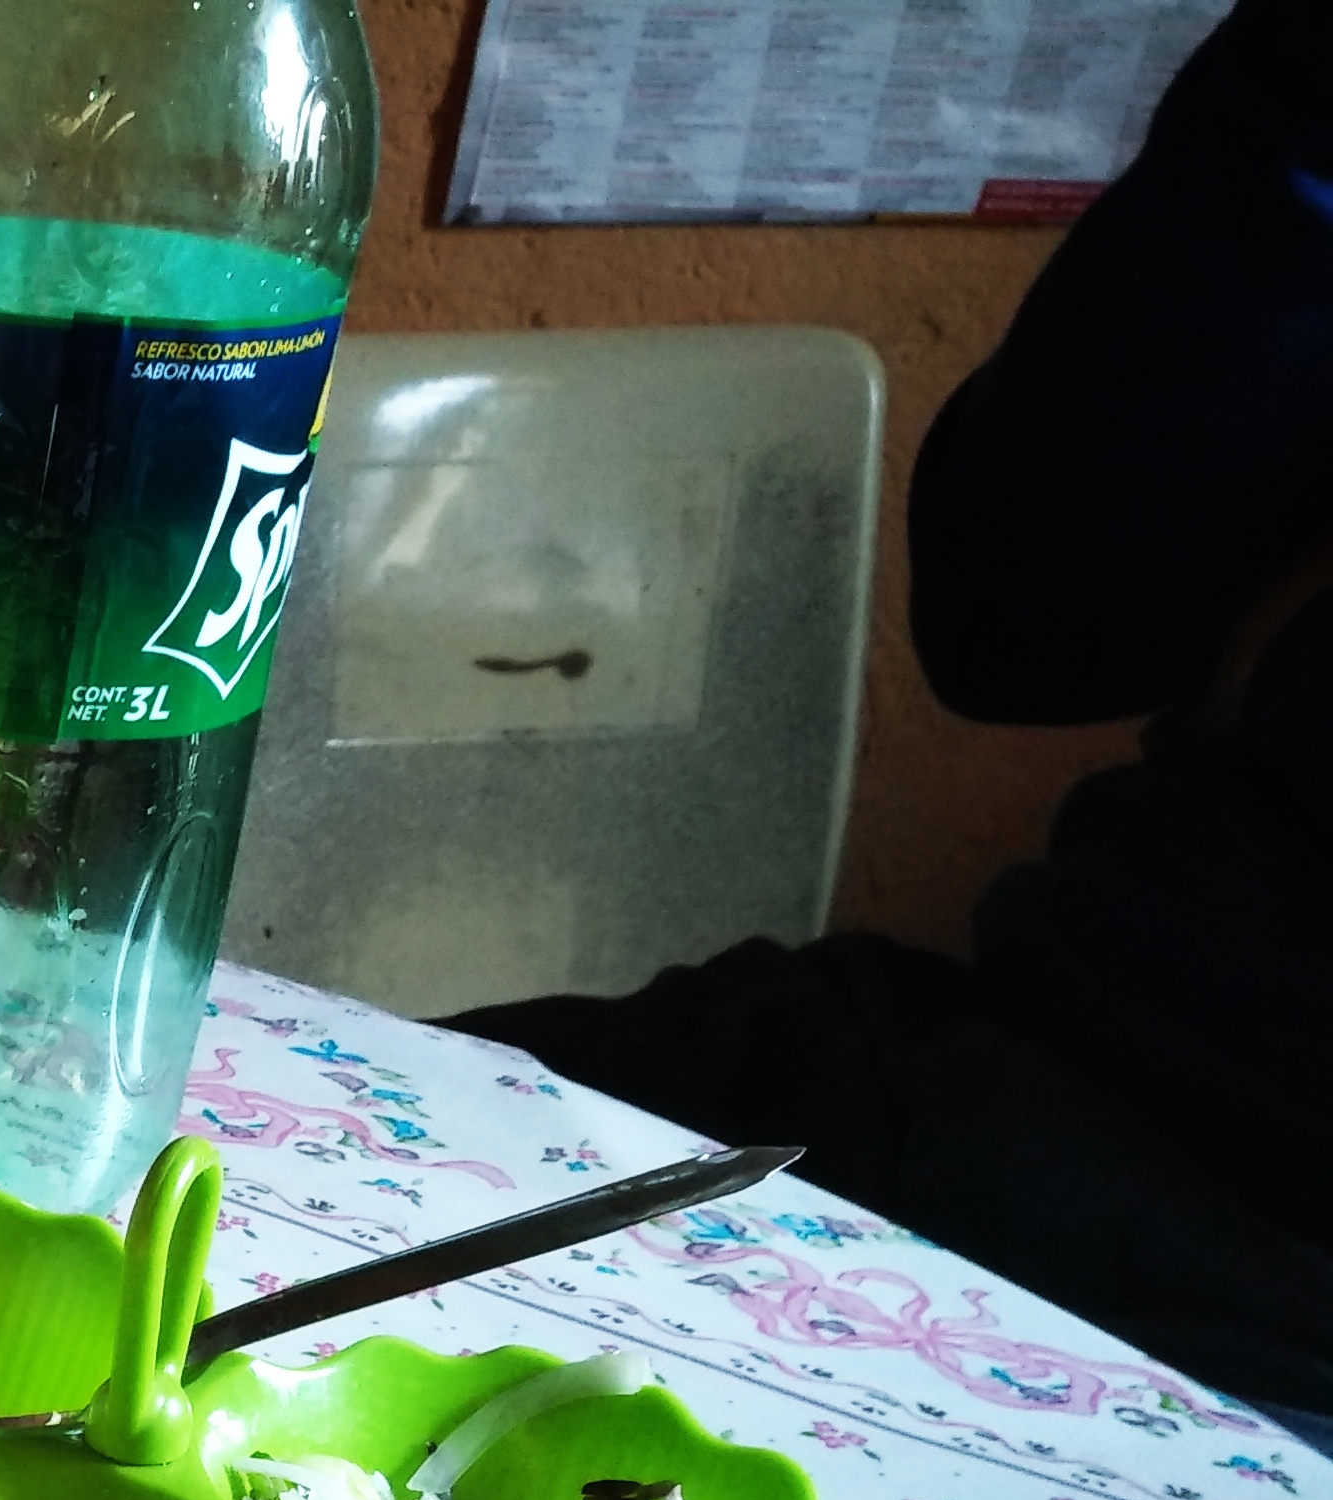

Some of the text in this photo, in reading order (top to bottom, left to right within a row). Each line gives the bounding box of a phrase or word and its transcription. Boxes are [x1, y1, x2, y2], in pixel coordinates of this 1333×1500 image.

[135, 340, 222, 361] REFRESCO
[222, 339, 270, 361] SABOR
[131, 361, 258, 382] SABOR NATURAL
[71, 685, 128, 703] CONT.
[122, 684, 171, 722] 3L
[67, 704, 109, 722] NET.
